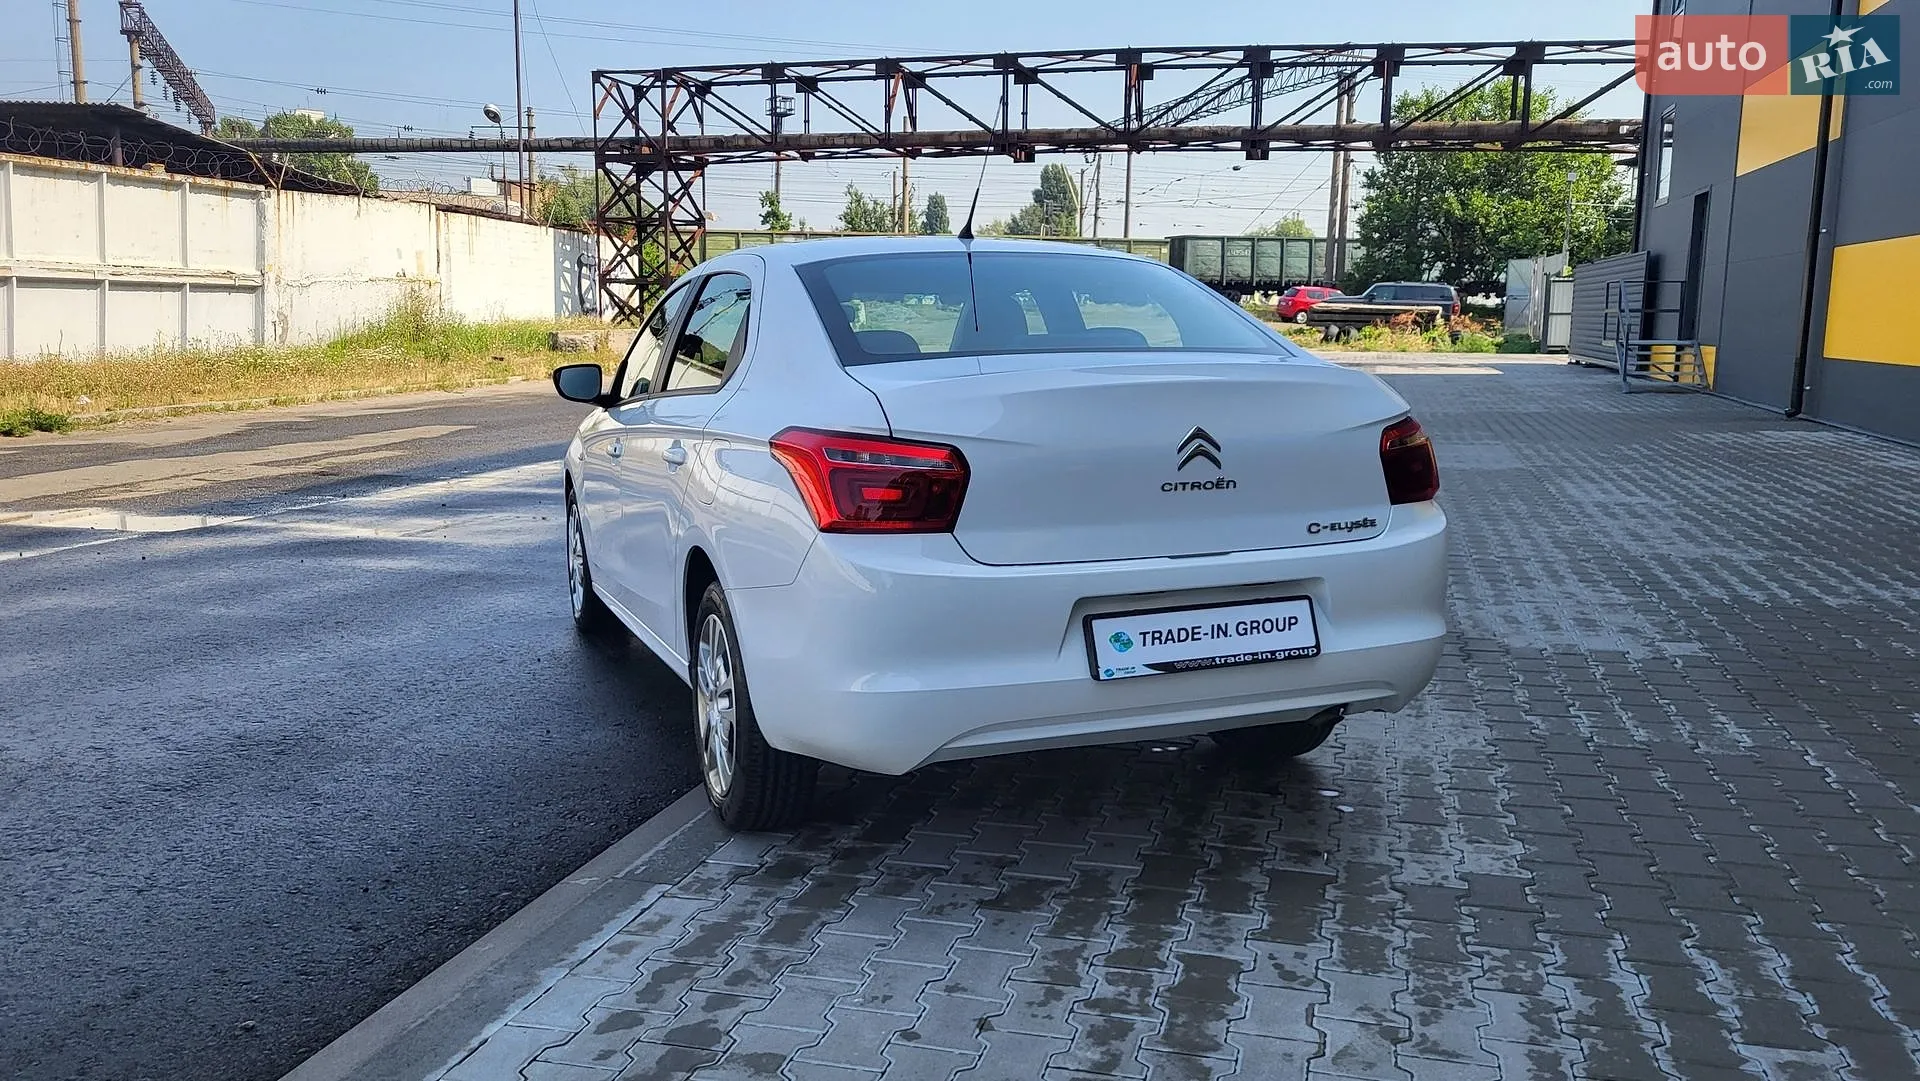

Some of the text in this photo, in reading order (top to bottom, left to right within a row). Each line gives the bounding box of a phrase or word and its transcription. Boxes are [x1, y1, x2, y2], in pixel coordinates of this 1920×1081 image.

[1161, 477, 1237, 492] CITROËN
[1236, 615, 1299, 637] GROUP
[1173, 646, 1317, 669] www.trade-in.group
